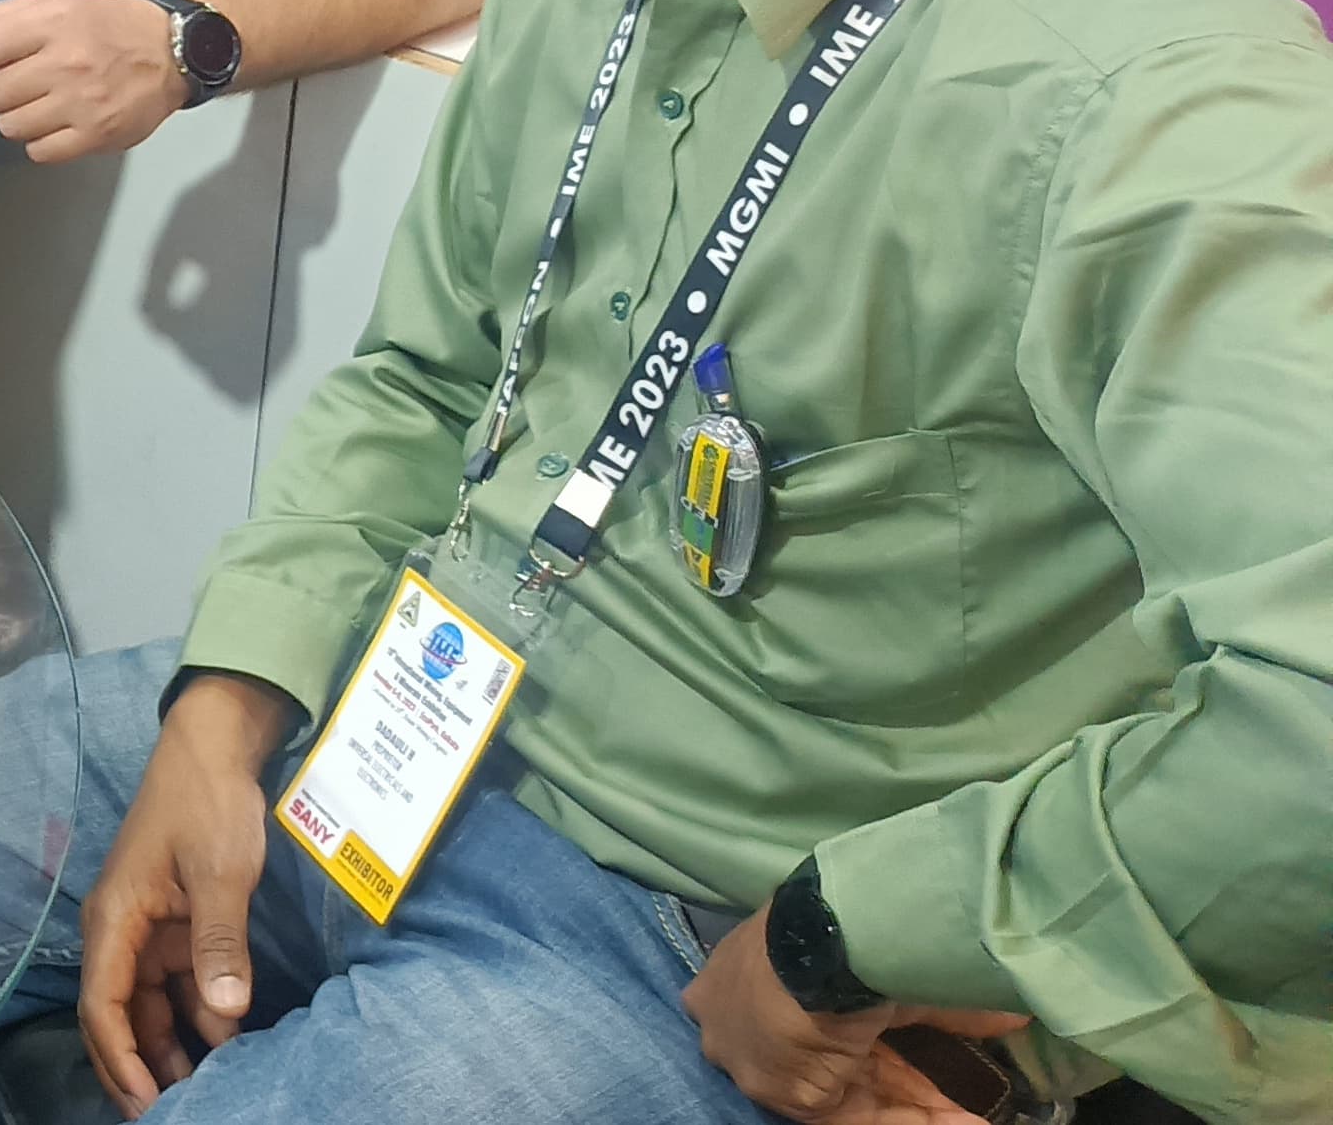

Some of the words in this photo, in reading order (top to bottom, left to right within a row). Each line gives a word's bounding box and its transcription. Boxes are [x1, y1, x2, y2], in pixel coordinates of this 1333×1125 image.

[560, 122, 595, 199] IME
[590, 11, 637, 112] 2023
[808, 2, 883, 88] IME
[704, 140, 793, 277] MGMI
[587, 430, 637, 497] ME
[617, 328, 692, 447] 2023
[289, 798, 335, 844] SANY
[340, 842, 394, 900] EXHIBITOR
